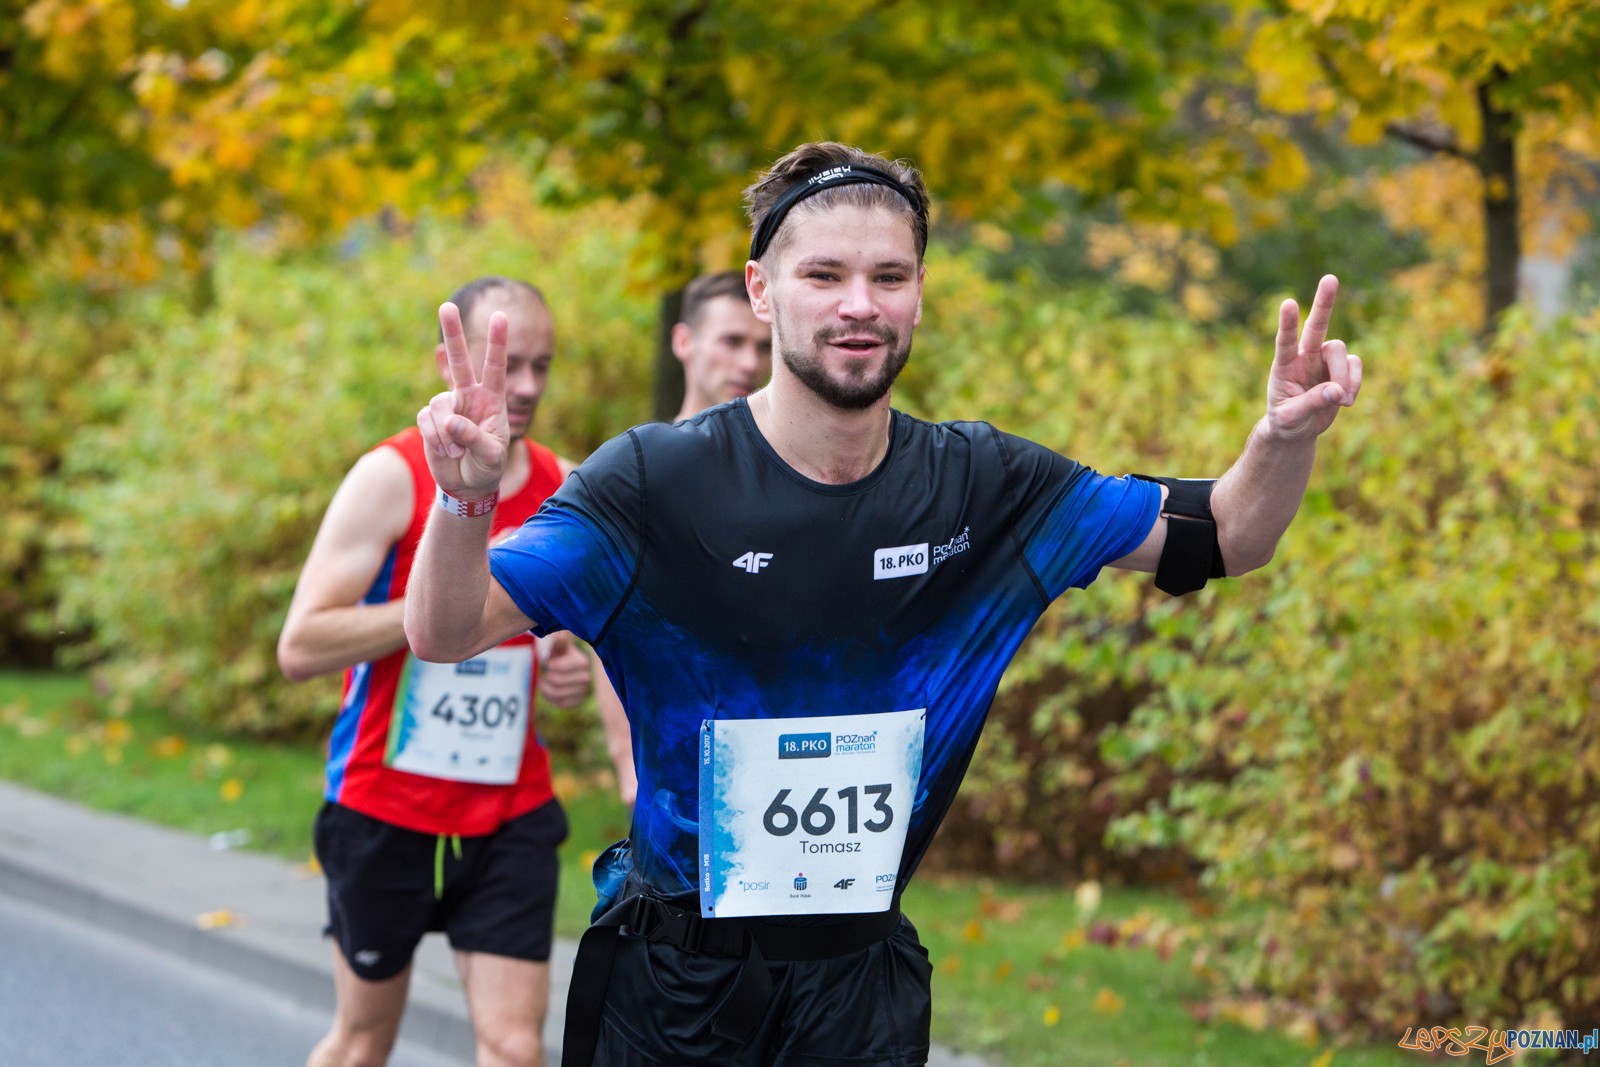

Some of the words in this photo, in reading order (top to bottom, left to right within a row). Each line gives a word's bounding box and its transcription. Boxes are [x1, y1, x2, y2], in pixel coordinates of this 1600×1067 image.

[732, 551, 774, 574] 4F
[879, 557, 896, 570] 18.
[898, 552, 924, 568] PKO
[431, 692, 520, 728] 4309
[703, 734, 711, 765] 15.10.2017
[783, 741, 800, 752] 18.
[801, 739, 827, 751] PKO
[835, 742, 876, 752] maraton
[763, 783, 894, 837] 6613
[799, 840, 862, 854] Tomasz
[833, 878, 856, 890] 4F
